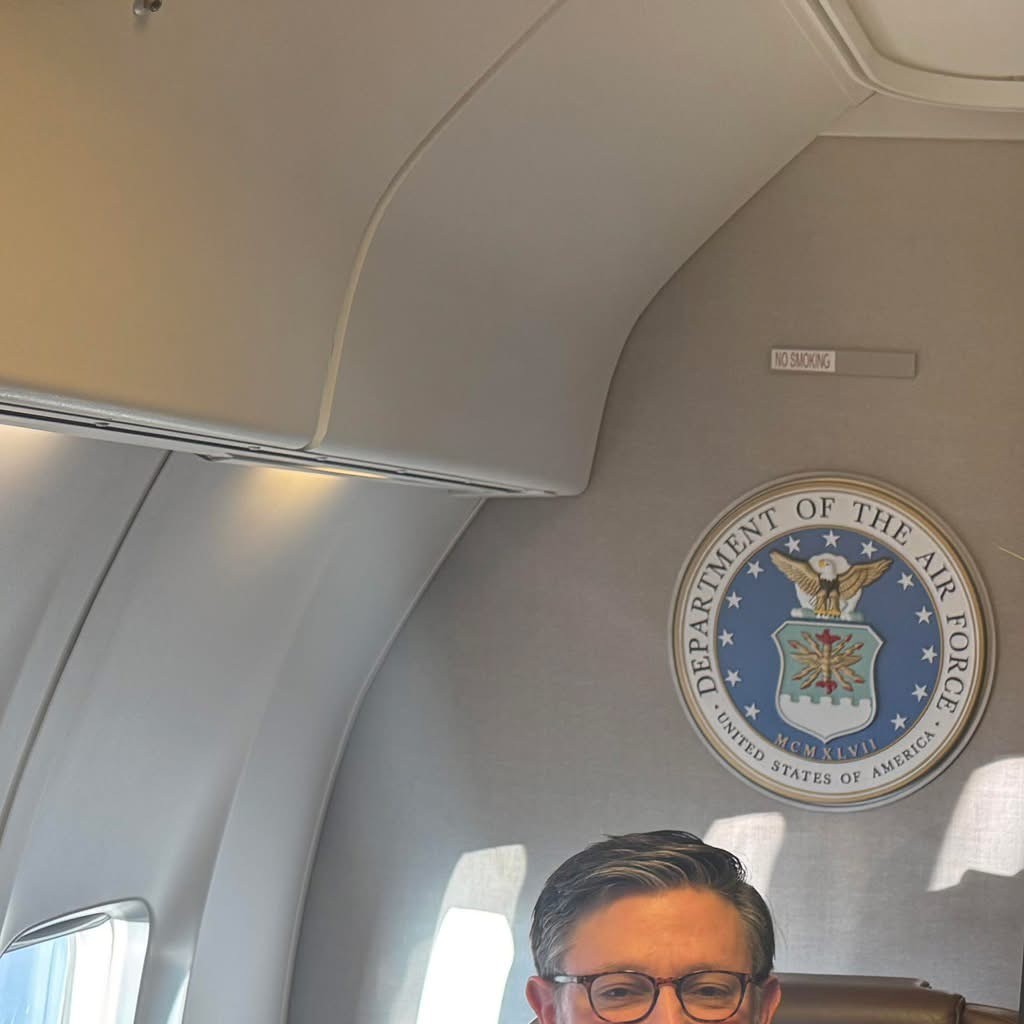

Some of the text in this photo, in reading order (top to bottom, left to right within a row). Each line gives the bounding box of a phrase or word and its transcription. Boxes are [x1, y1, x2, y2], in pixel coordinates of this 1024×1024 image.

[775, 351, 831, 369] NO SMOKING
[689, 497, 970, 715] DEPARTMENT OF THE AIR FORCE
[716, 711, 935, 785] UNITED STATES OF AMERICA
[774, 733, 878, 761] MCMXLVII
